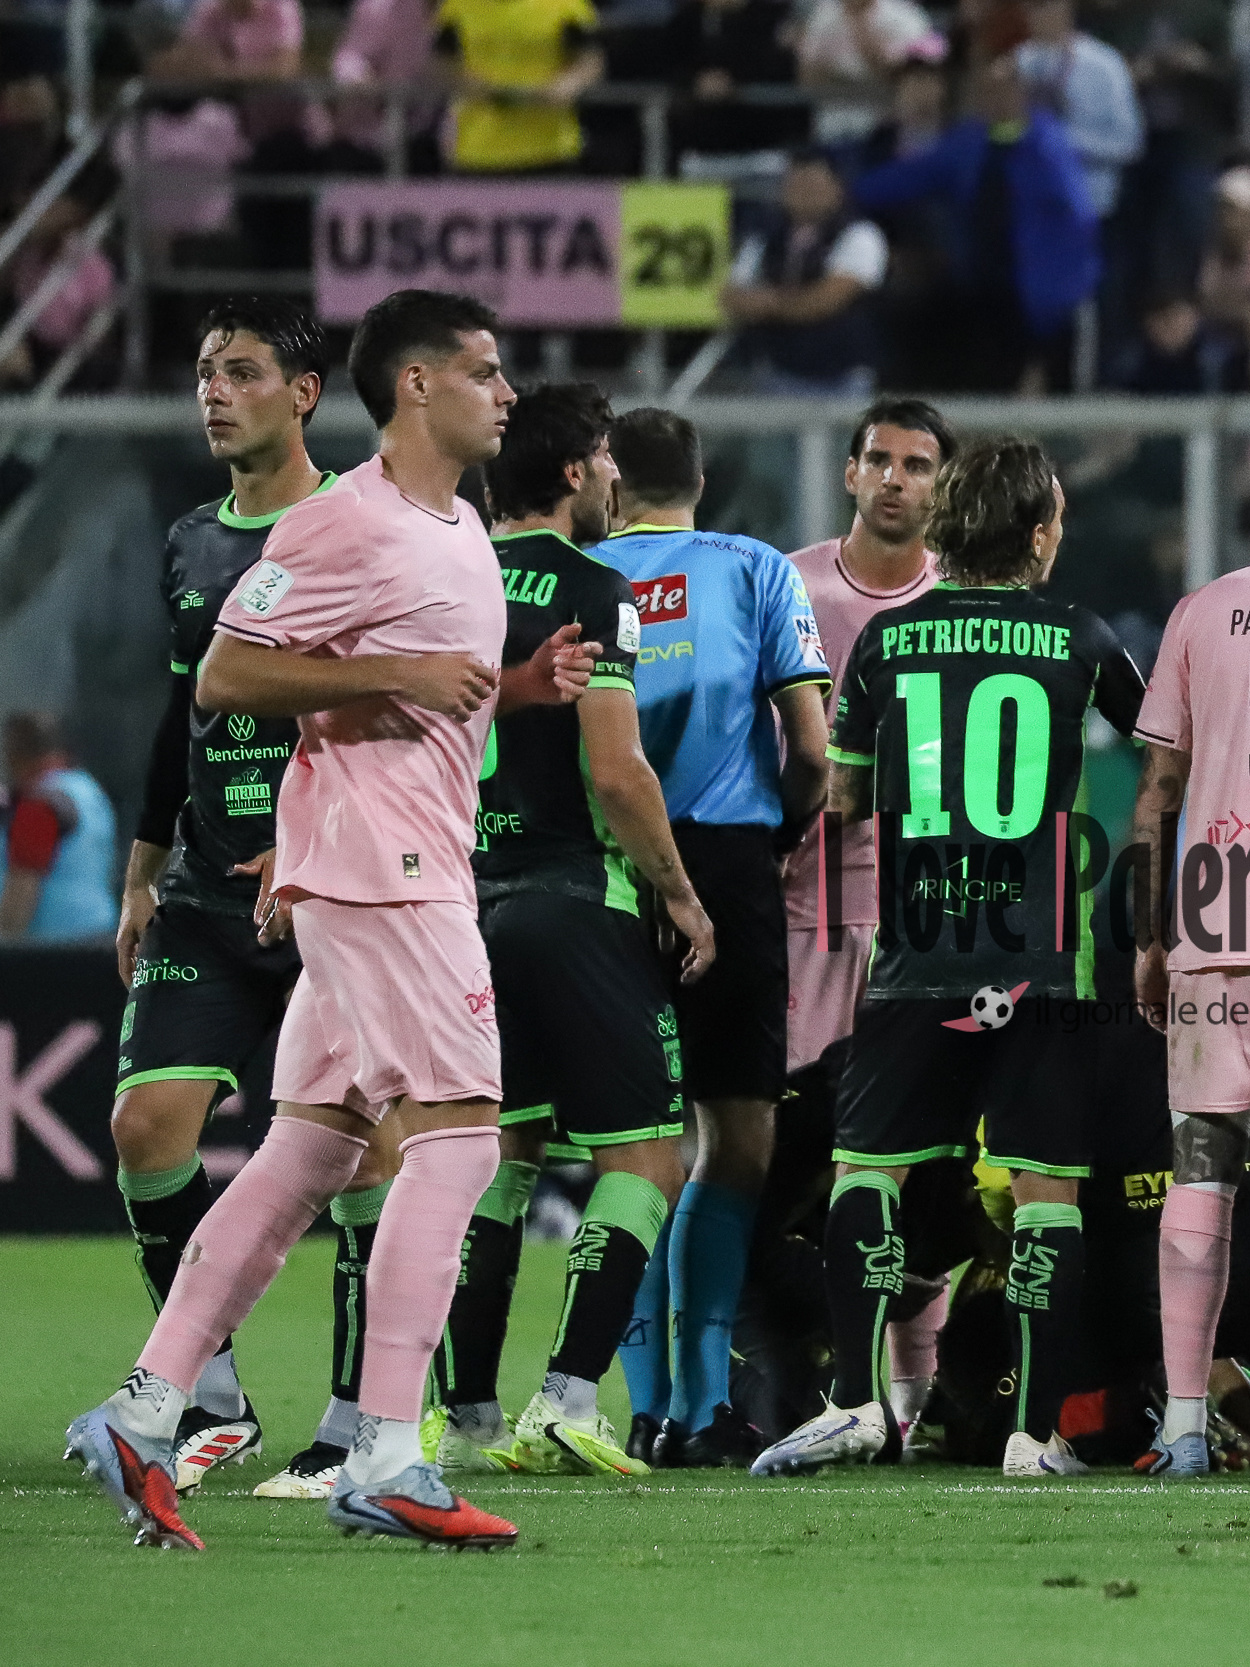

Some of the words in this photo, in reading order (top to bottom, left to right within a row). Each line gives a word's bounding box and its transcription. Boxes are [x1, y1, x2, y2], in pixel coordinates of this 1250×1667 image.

[328, 211, 612, 277] USCITA
[632, 223, 715, 290] 29
[500, 568, 558, 607] LLO
[882, 617, 1071, 660] PETRICCIONE
[205, 742, 290, 762] Bencivenni
[896, 672, 1050, 840] 10
[911, 878, 1022, 902] PRINCIPE
[862, 1272, 903, 1296] 1929
